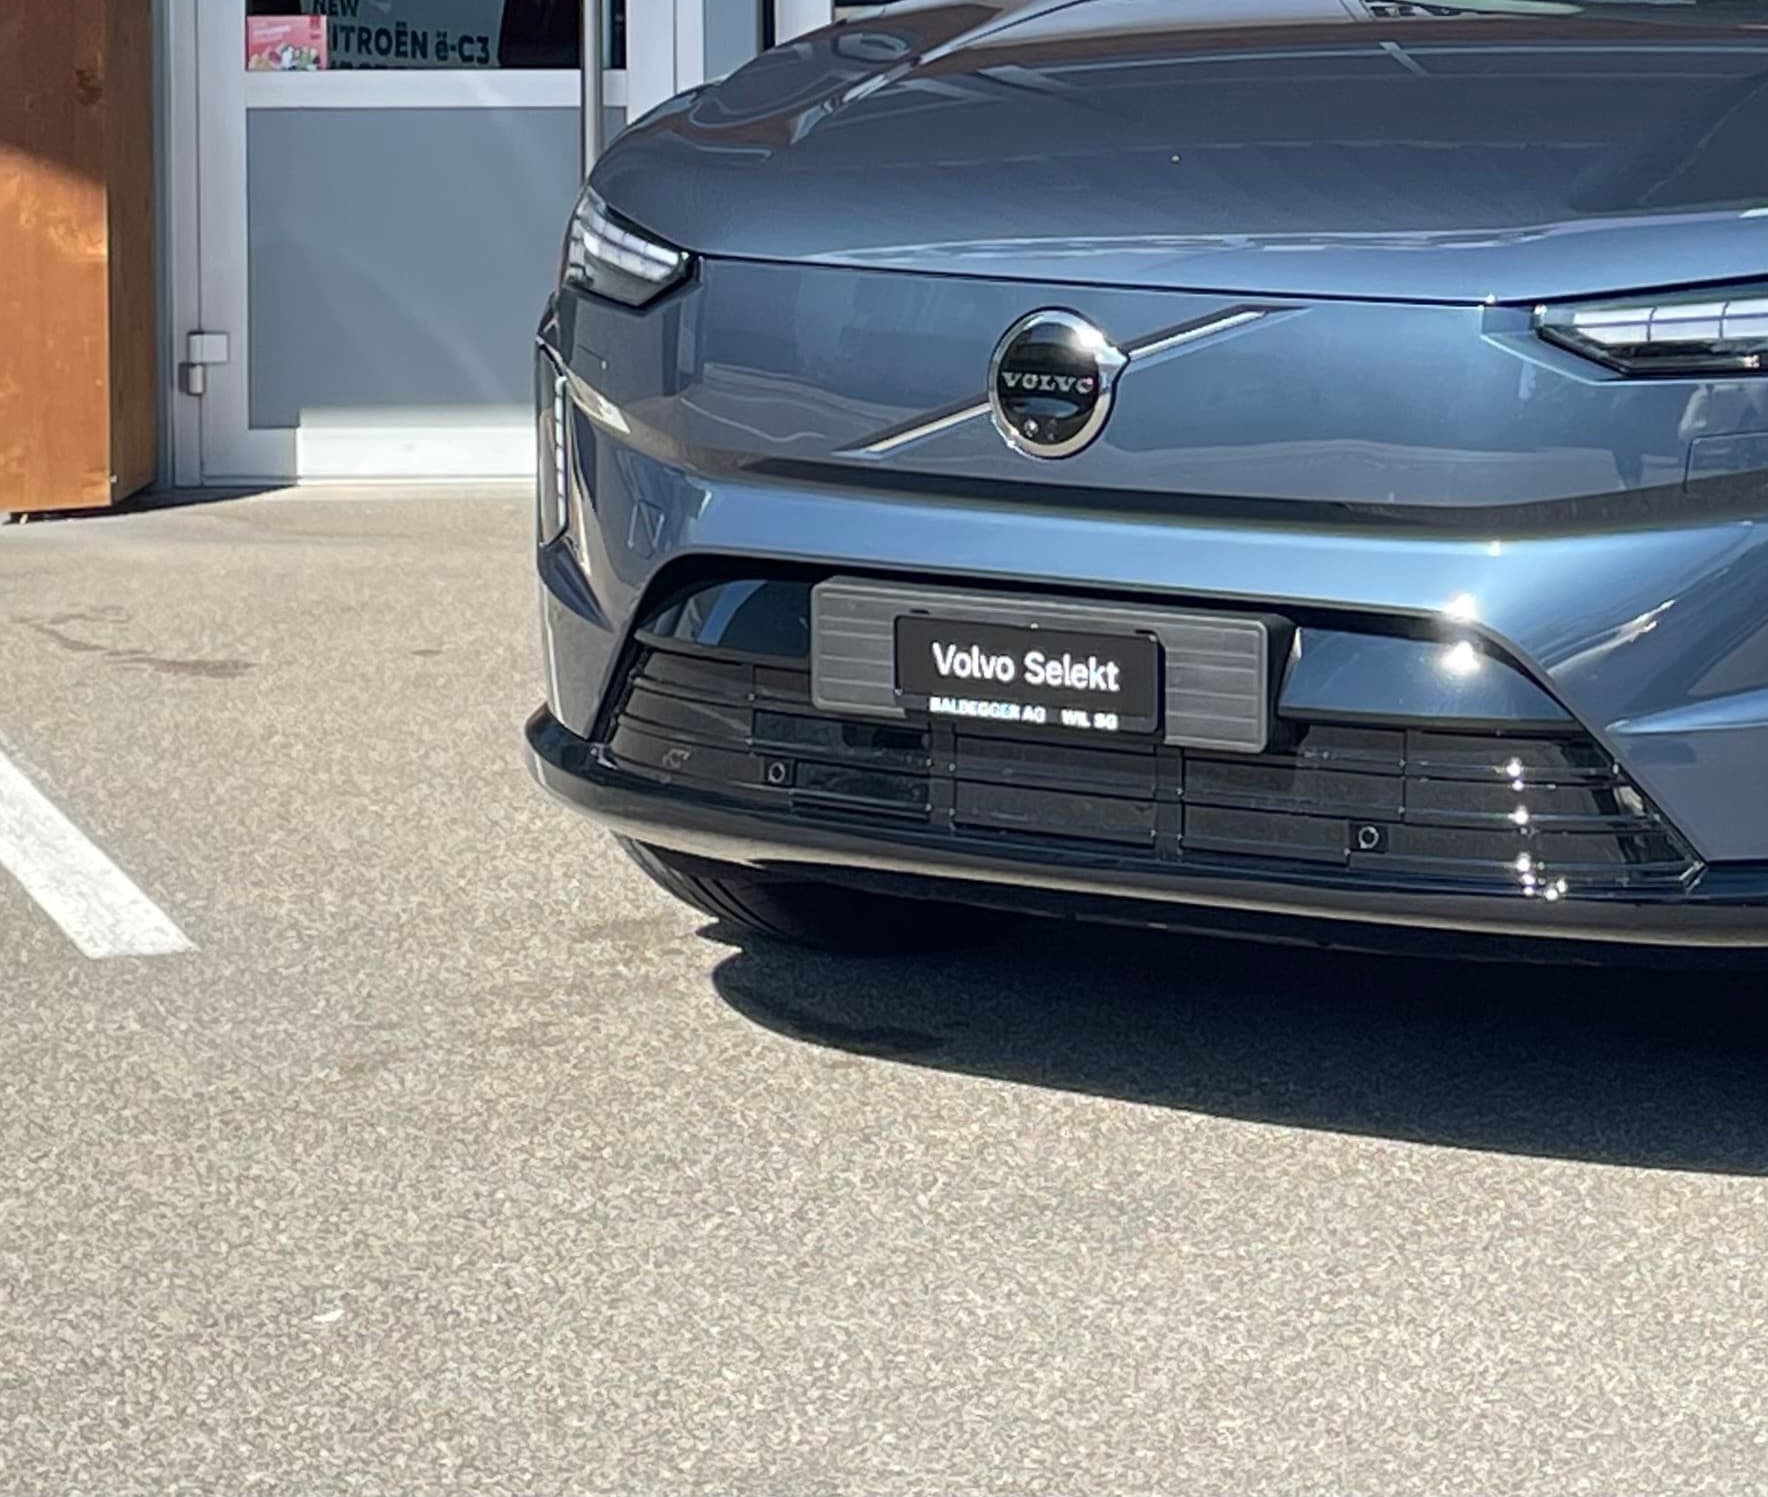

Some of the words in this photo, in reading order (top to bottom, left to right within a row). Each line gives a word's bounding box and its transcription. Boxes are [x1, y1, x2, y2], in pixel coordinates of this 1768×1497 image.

[329, 21, 429, 60] ITROËN
[435, 31, 491, 66] ë-C3
[1001, 371, 1094, 394] VOLVO
[932, 641, 1016, 682] Volvo
[1023, 650, 1120, 692] Selekt
[929, 696, 1020, 721] BALDEGGER
[1021, 704, 1047, 724] AG
[1061, 708, 1092, 728] WIL
[1093, 712, 1119, 731] SG
